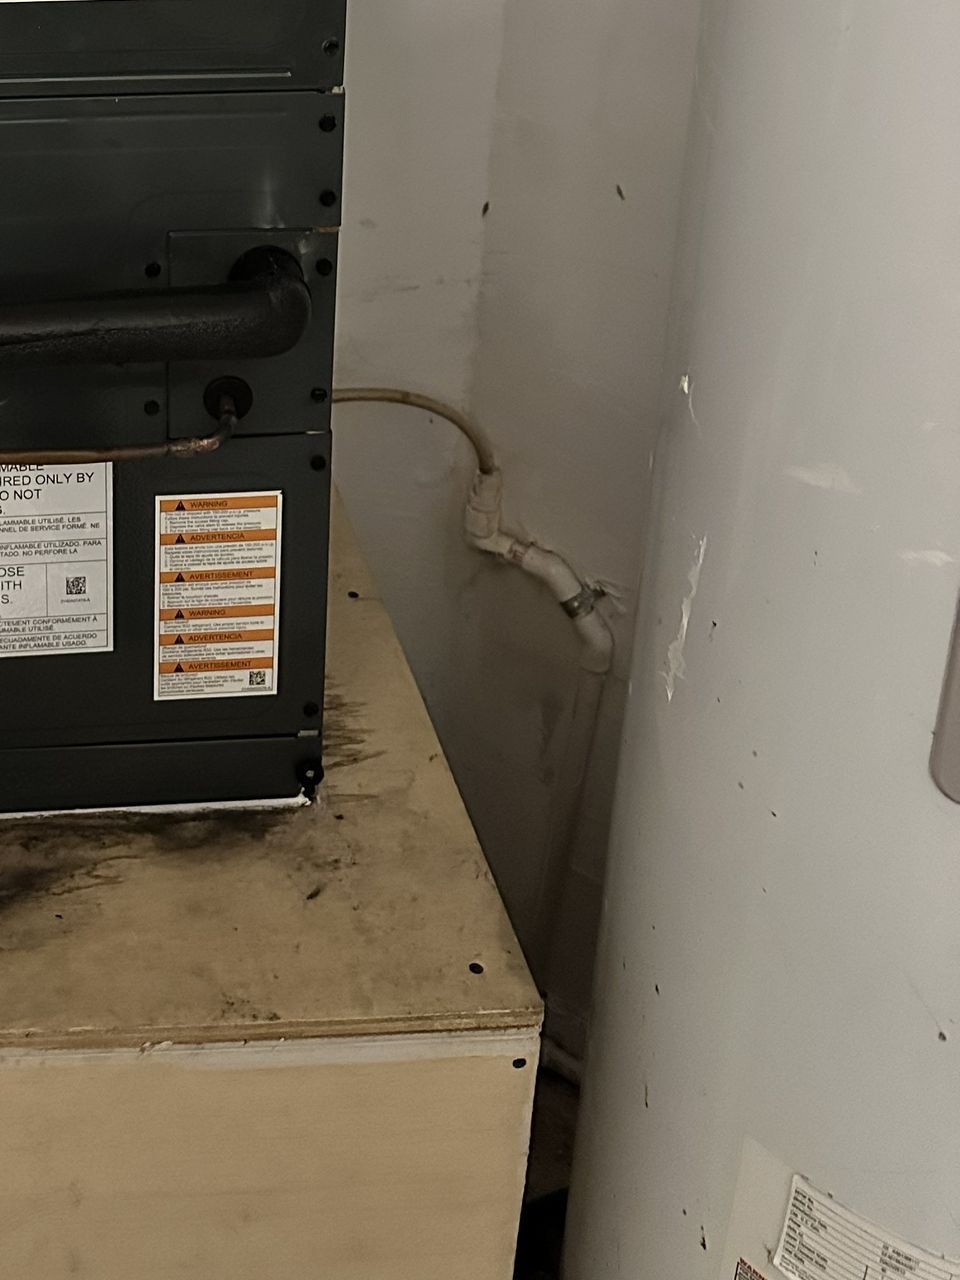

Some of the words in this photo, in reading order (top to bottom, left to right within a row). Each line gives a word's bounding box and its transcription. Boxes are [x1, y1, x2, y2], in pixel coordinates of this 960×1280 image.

[35, 473, 72, 485] ONLY
[76, 472, 94, 482] BY
[13, 489, 42, 500] NOT
[190, 500, 228, 508] WARNING
[190, 532, 244, 541] ADVERTENCIA
[189, 571, 254, 580] AVERTISSEMENT
